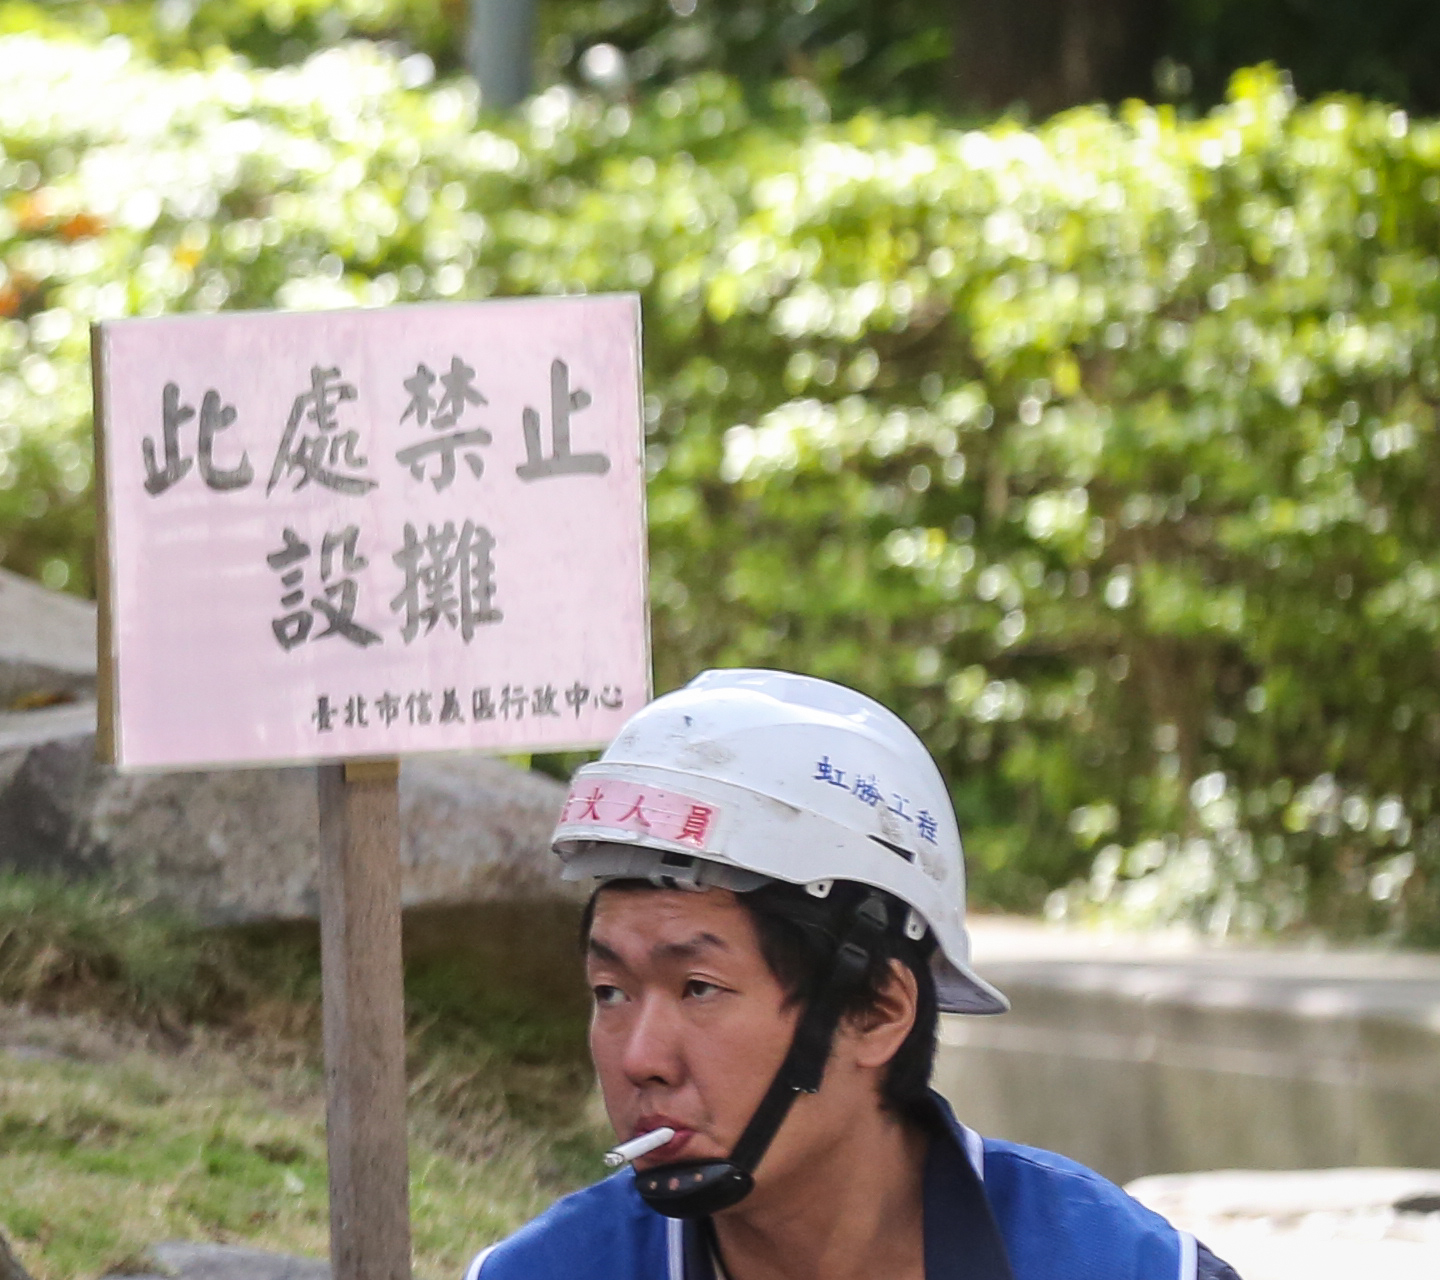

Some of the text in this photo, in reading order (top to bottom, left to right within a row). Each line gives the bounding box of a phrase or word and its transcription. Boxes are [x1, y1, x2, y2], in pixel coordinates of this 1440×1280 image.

[142, 355, 611, 498] 此處禁止
[266, 519, 504, 651] 設攤
[311, 682, 624, 734] 臺北市信義區行政中心
